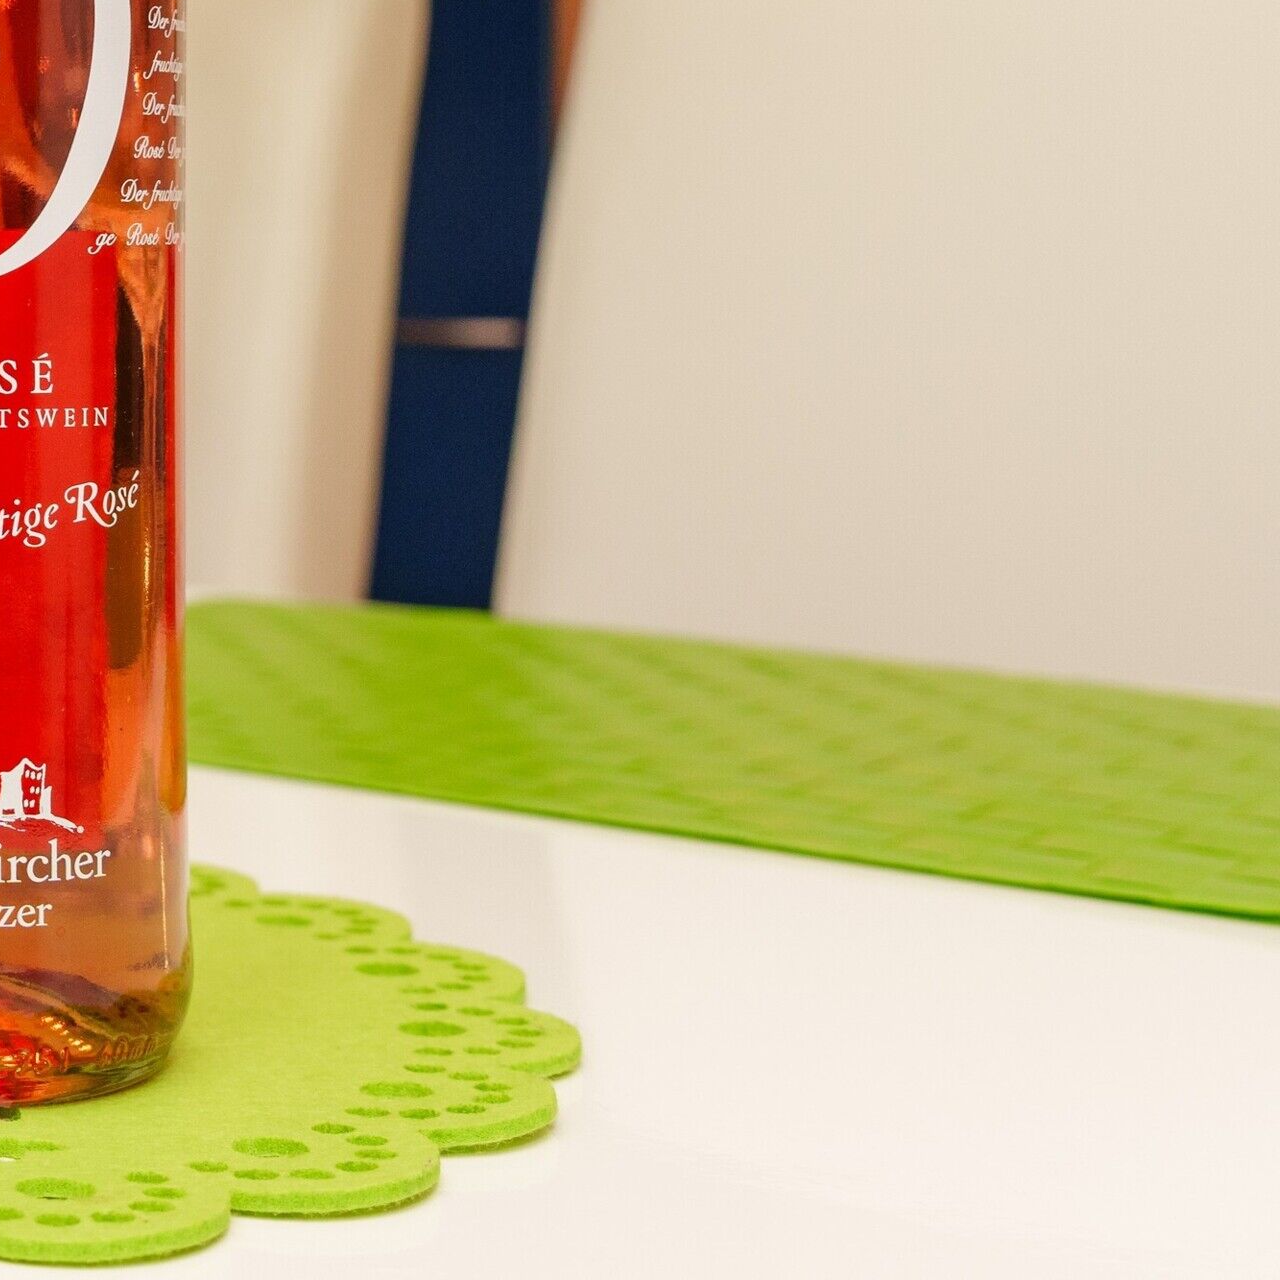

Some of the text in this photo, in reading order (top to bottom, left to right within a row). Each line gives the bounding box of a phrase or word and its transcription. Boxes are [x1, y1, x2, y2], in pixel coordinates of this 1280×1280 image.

[148, 6, 169, 29] Der
[142, 92, 165, 116] Der
[134, 136, 165, 159] Rosé
[121, 179, 148, 203] Der
[88, 233, 116, 255] ge
[127, 222, 160, 246] Rosé
[64, 470, 140, 527] Rosé
